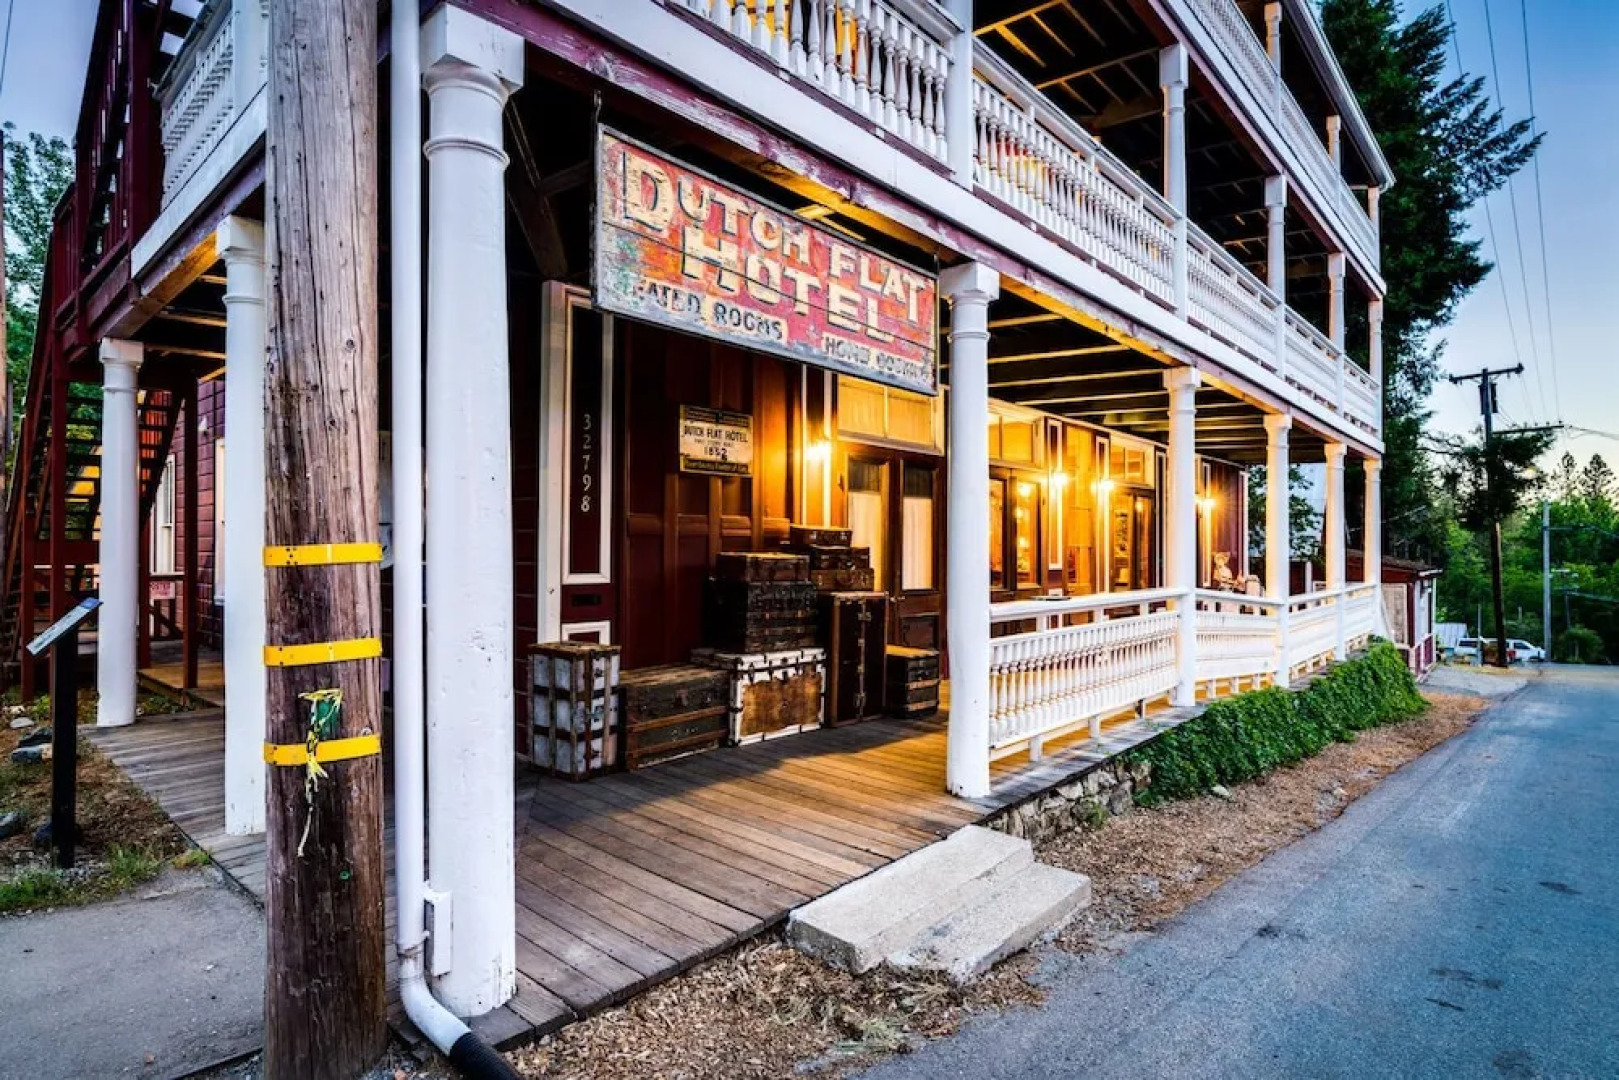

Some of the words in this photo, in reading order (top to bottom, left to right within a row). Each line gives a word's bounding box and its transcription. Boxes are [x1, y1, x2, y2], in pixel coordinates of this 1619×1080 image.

[622, 151, 812, 266] DUTCH
[828, 242, 927, 324] FLAT
[682, 221, 894, 343] HOTEL
[707, 428, 722, 440] FLAT
[725, 430, 748, 443] HOTEL
